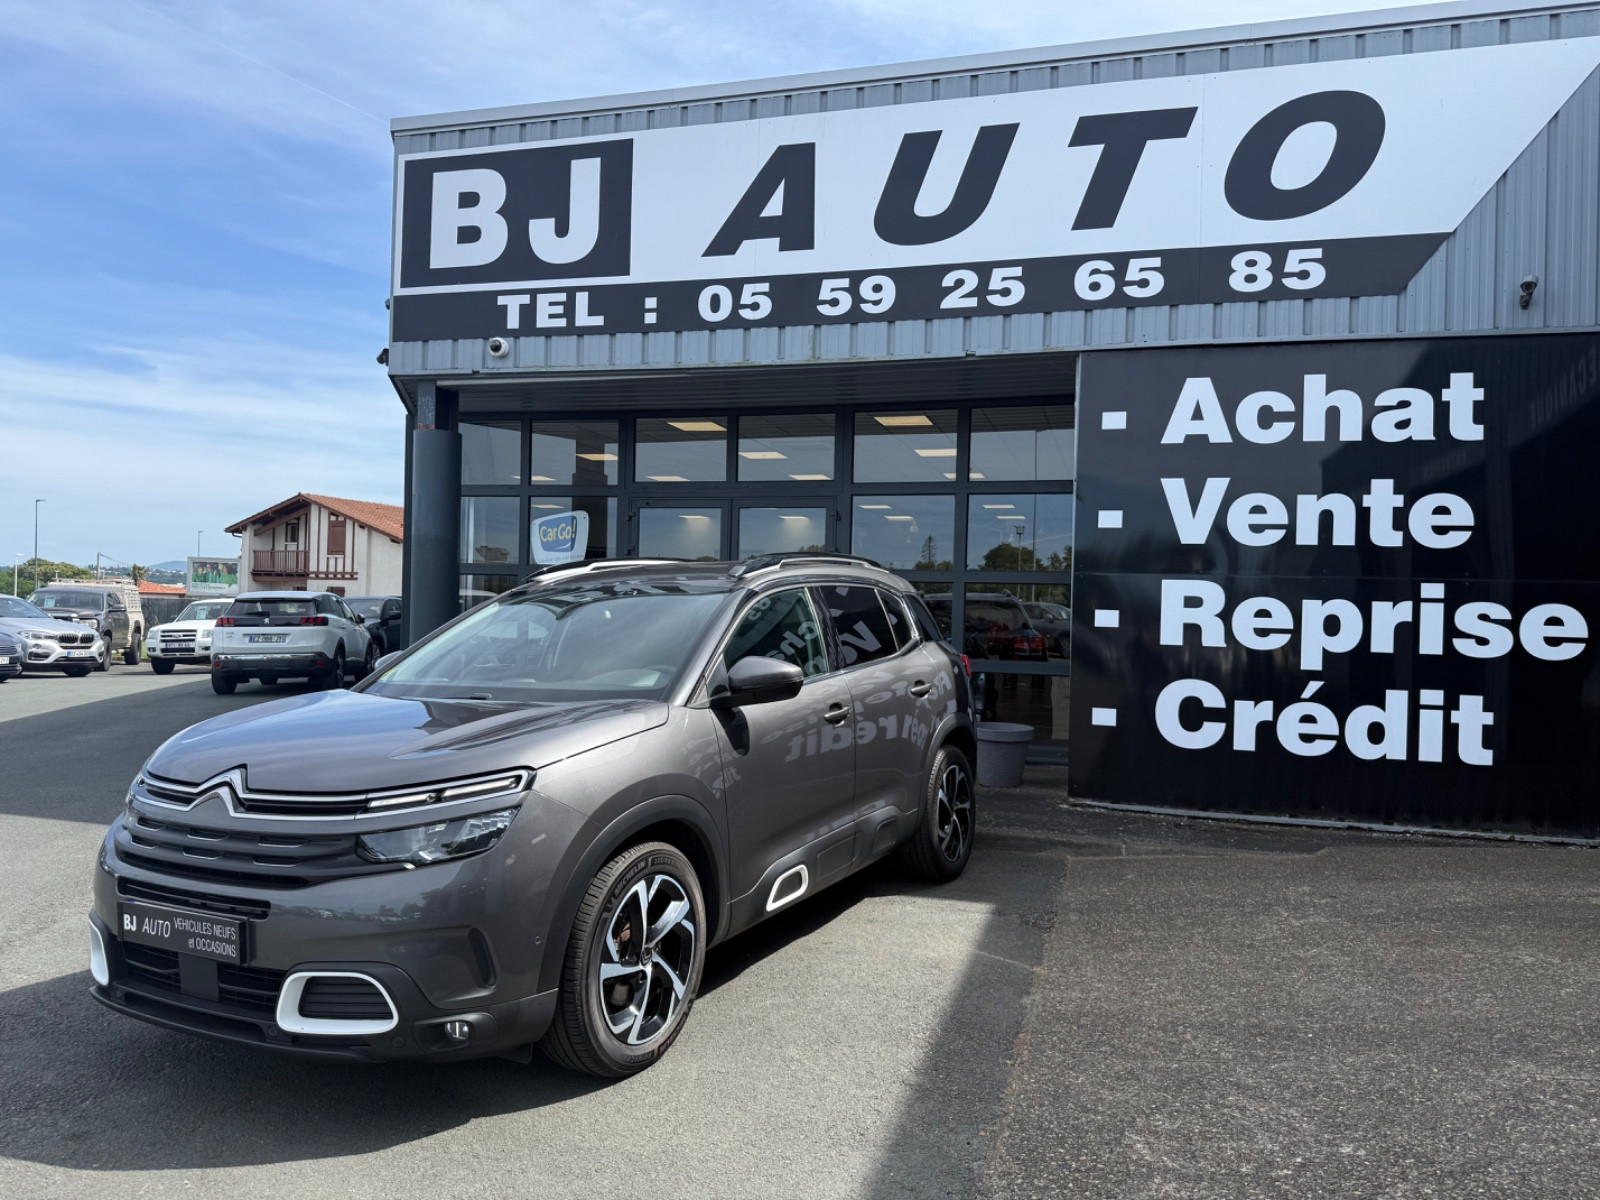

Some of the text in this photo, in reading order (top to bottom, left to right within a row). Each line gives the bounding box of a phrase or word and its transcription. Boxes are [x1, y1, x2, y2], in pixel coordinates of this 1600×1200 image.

[430, 91, 1385, 268] BJ AUTO
[497, 292, 604, 329] TEL
[698, 283, 772, 322] 05
[817, 275, 895, 313] 59
[940, 267, 1025, 308] 25
[1074, 257, 1164, 300] 65
[1229, 248, 1326, 292] 85
[1161, 373, 1485, 445] Achat
[1160, 478, 1475, 548] Vente
[1160, 580, 1588, 670] Reprise
[1155, 679, 1494, 765] Crédit
[123, 914, 171, 938] BJ AUTO
[173, 917, 236, 941] VEHICULES NEUFS
[195, 937, 237, 957] OCCASIONS
